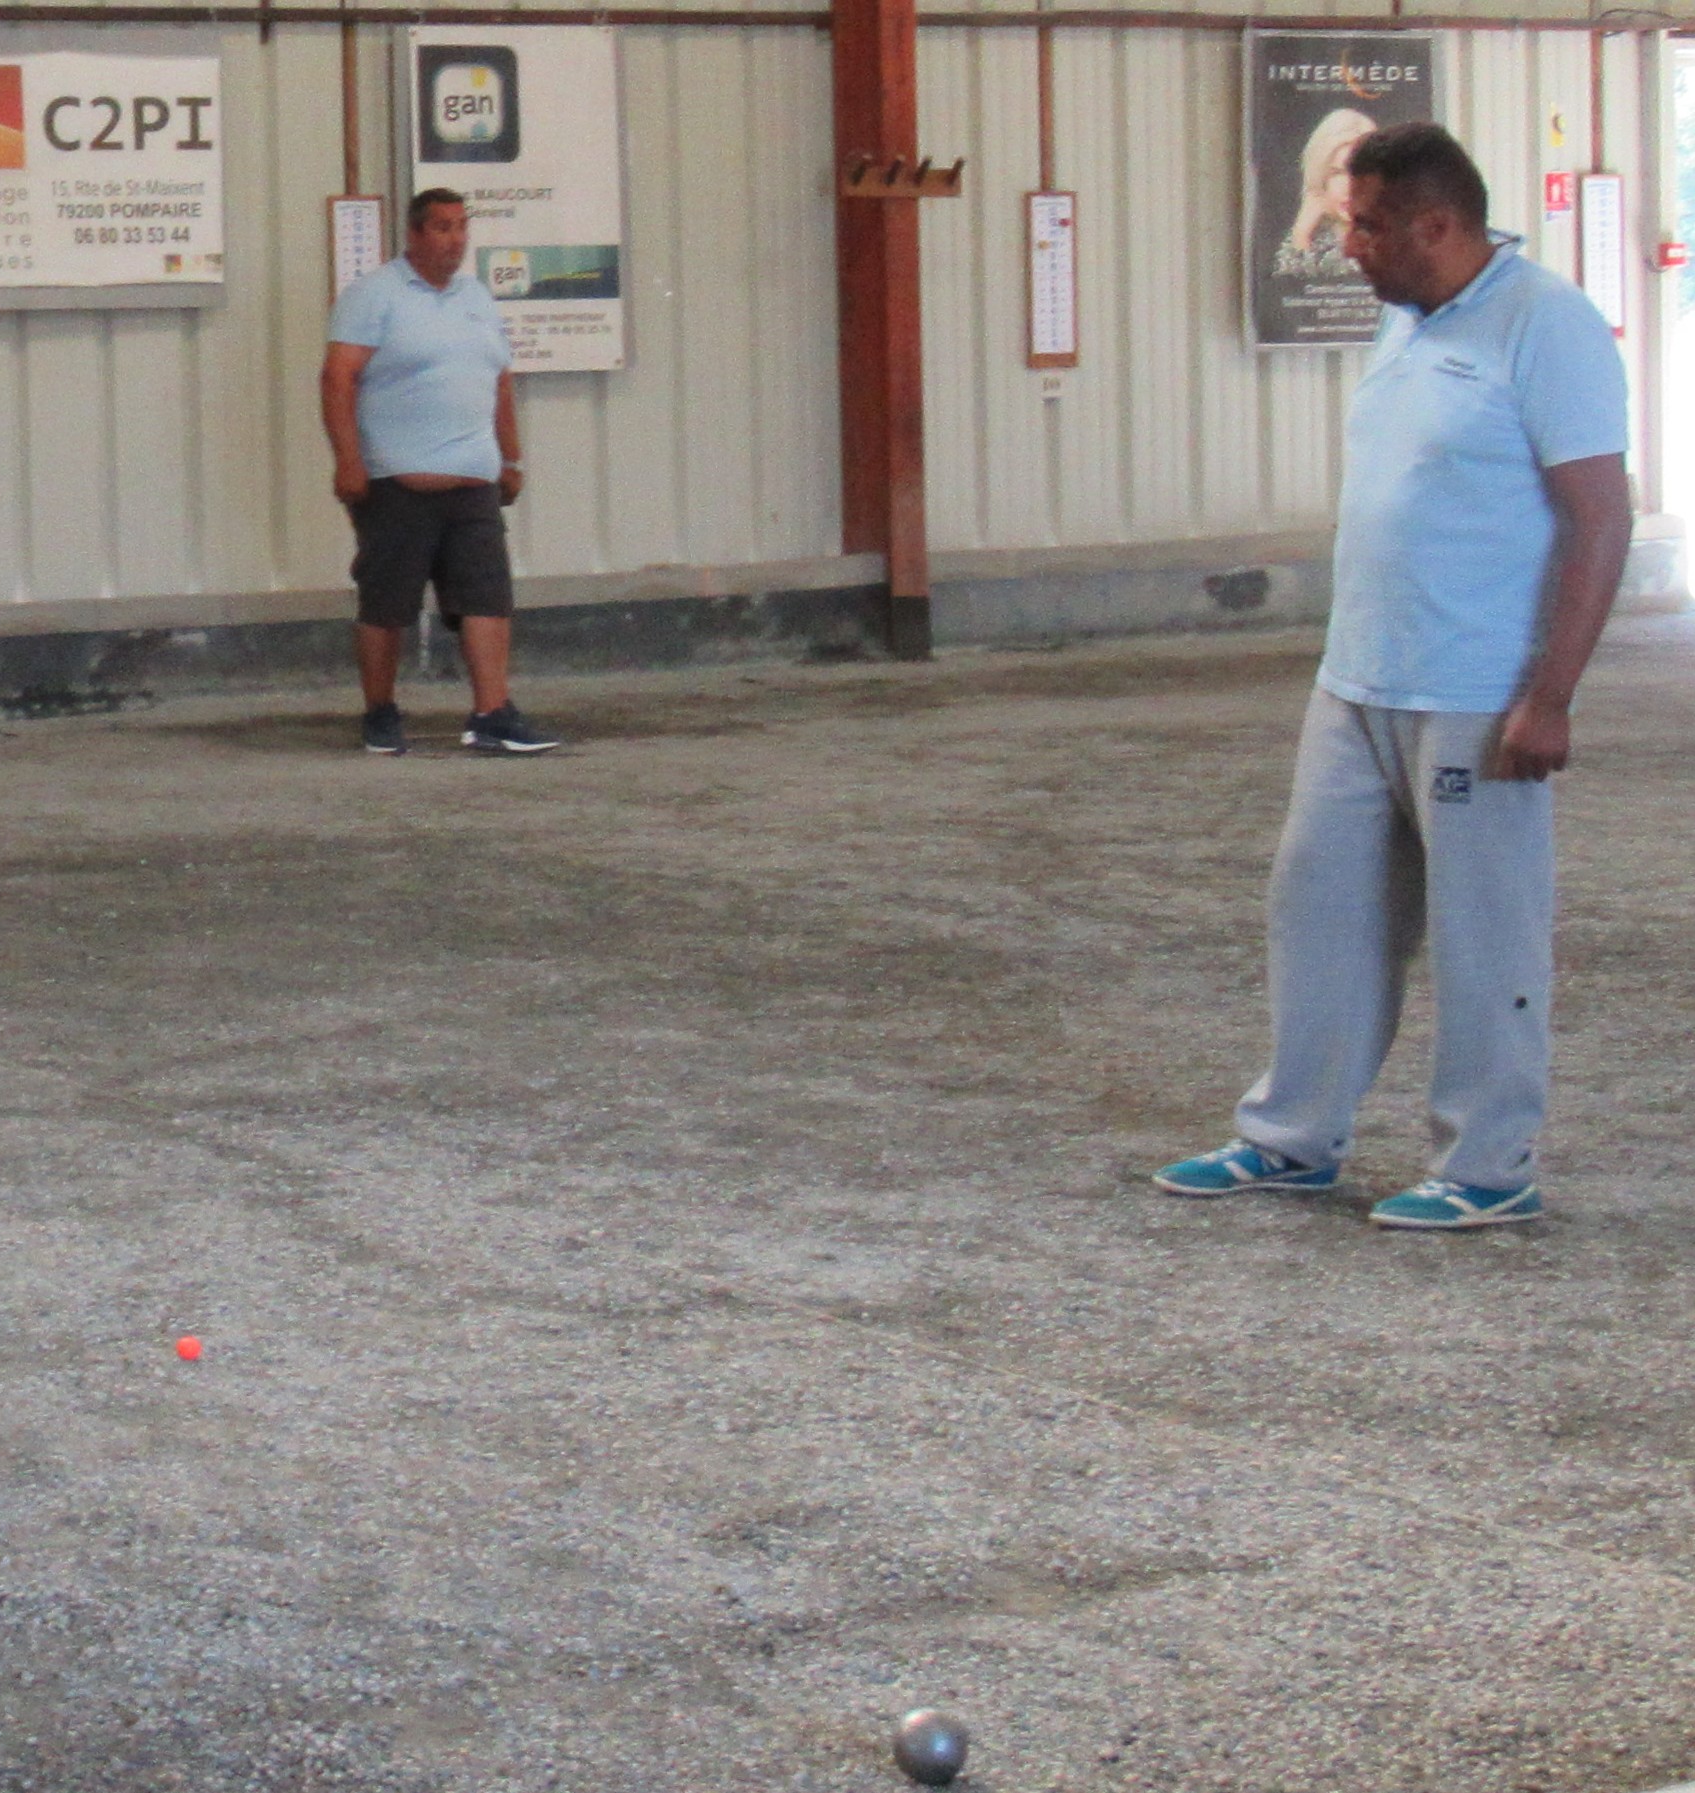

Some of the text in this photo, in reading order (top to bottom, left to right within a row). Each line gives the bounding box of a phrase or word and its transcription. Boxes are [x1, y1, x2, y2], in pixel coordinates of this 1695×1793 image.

[1267, 60, 1419, 82] INTERMÈDE
[442, 93, 495, 121] gan
[42, 95, 214, 152] C2PI
[105, 179, 122, 197] de
[57, 202, 202, 219] 79200 POMPAIRE
[74, 227, 95, 244] 06
[123, 227, 143, 244] 33
[171, 226, 191, 243] 44
[492, 265, 525, 285] gan
